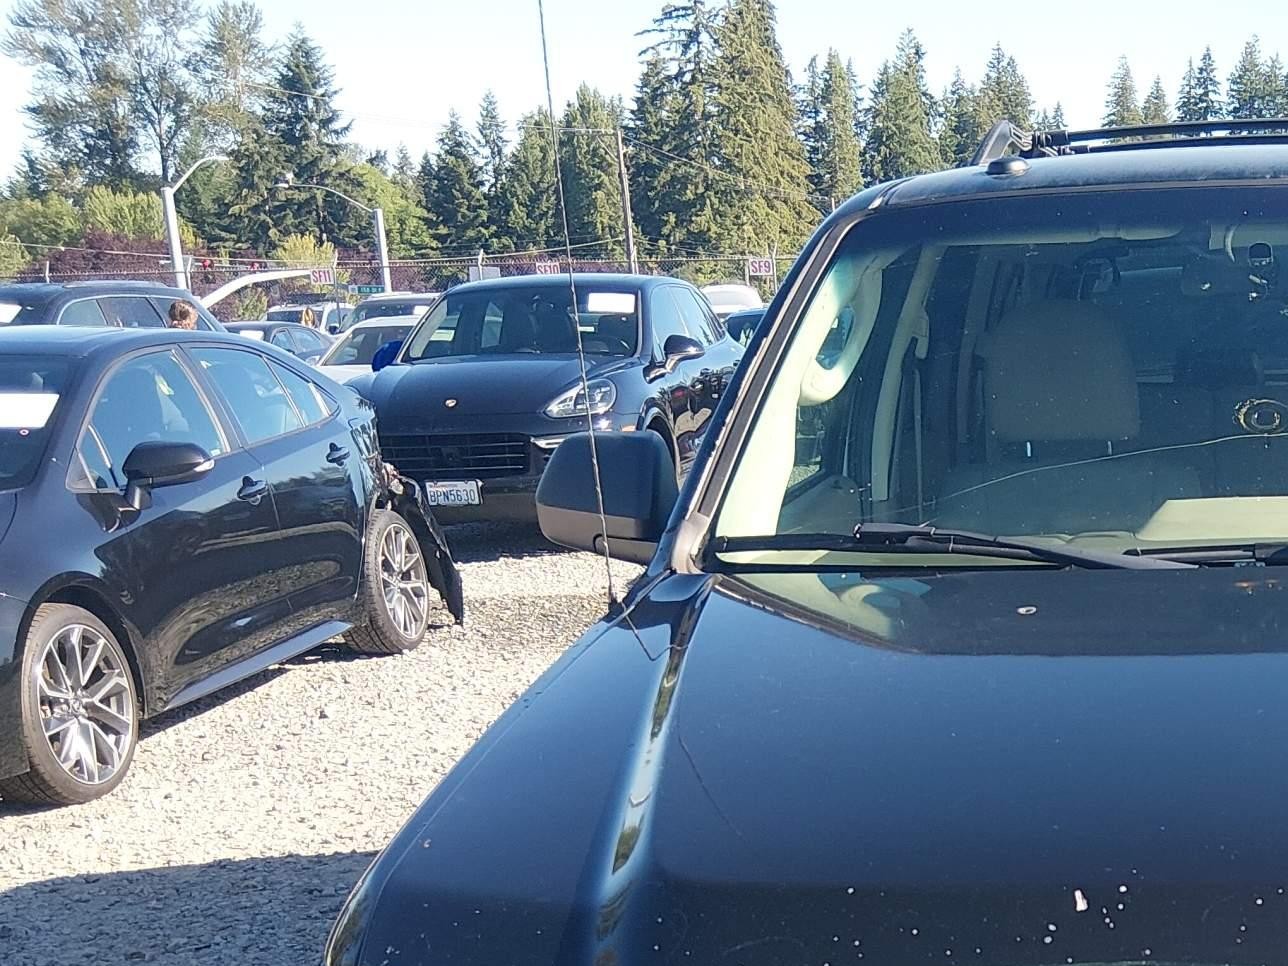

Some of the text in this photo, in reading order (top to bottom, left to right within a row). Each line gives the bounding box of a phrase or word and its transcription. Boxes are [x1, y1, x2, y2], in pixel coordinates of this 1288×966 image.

[751, 260, 771, 274] SF9
[311, 269, 332, 283] SF11
[429, 488, 476, 503] BPN5630
